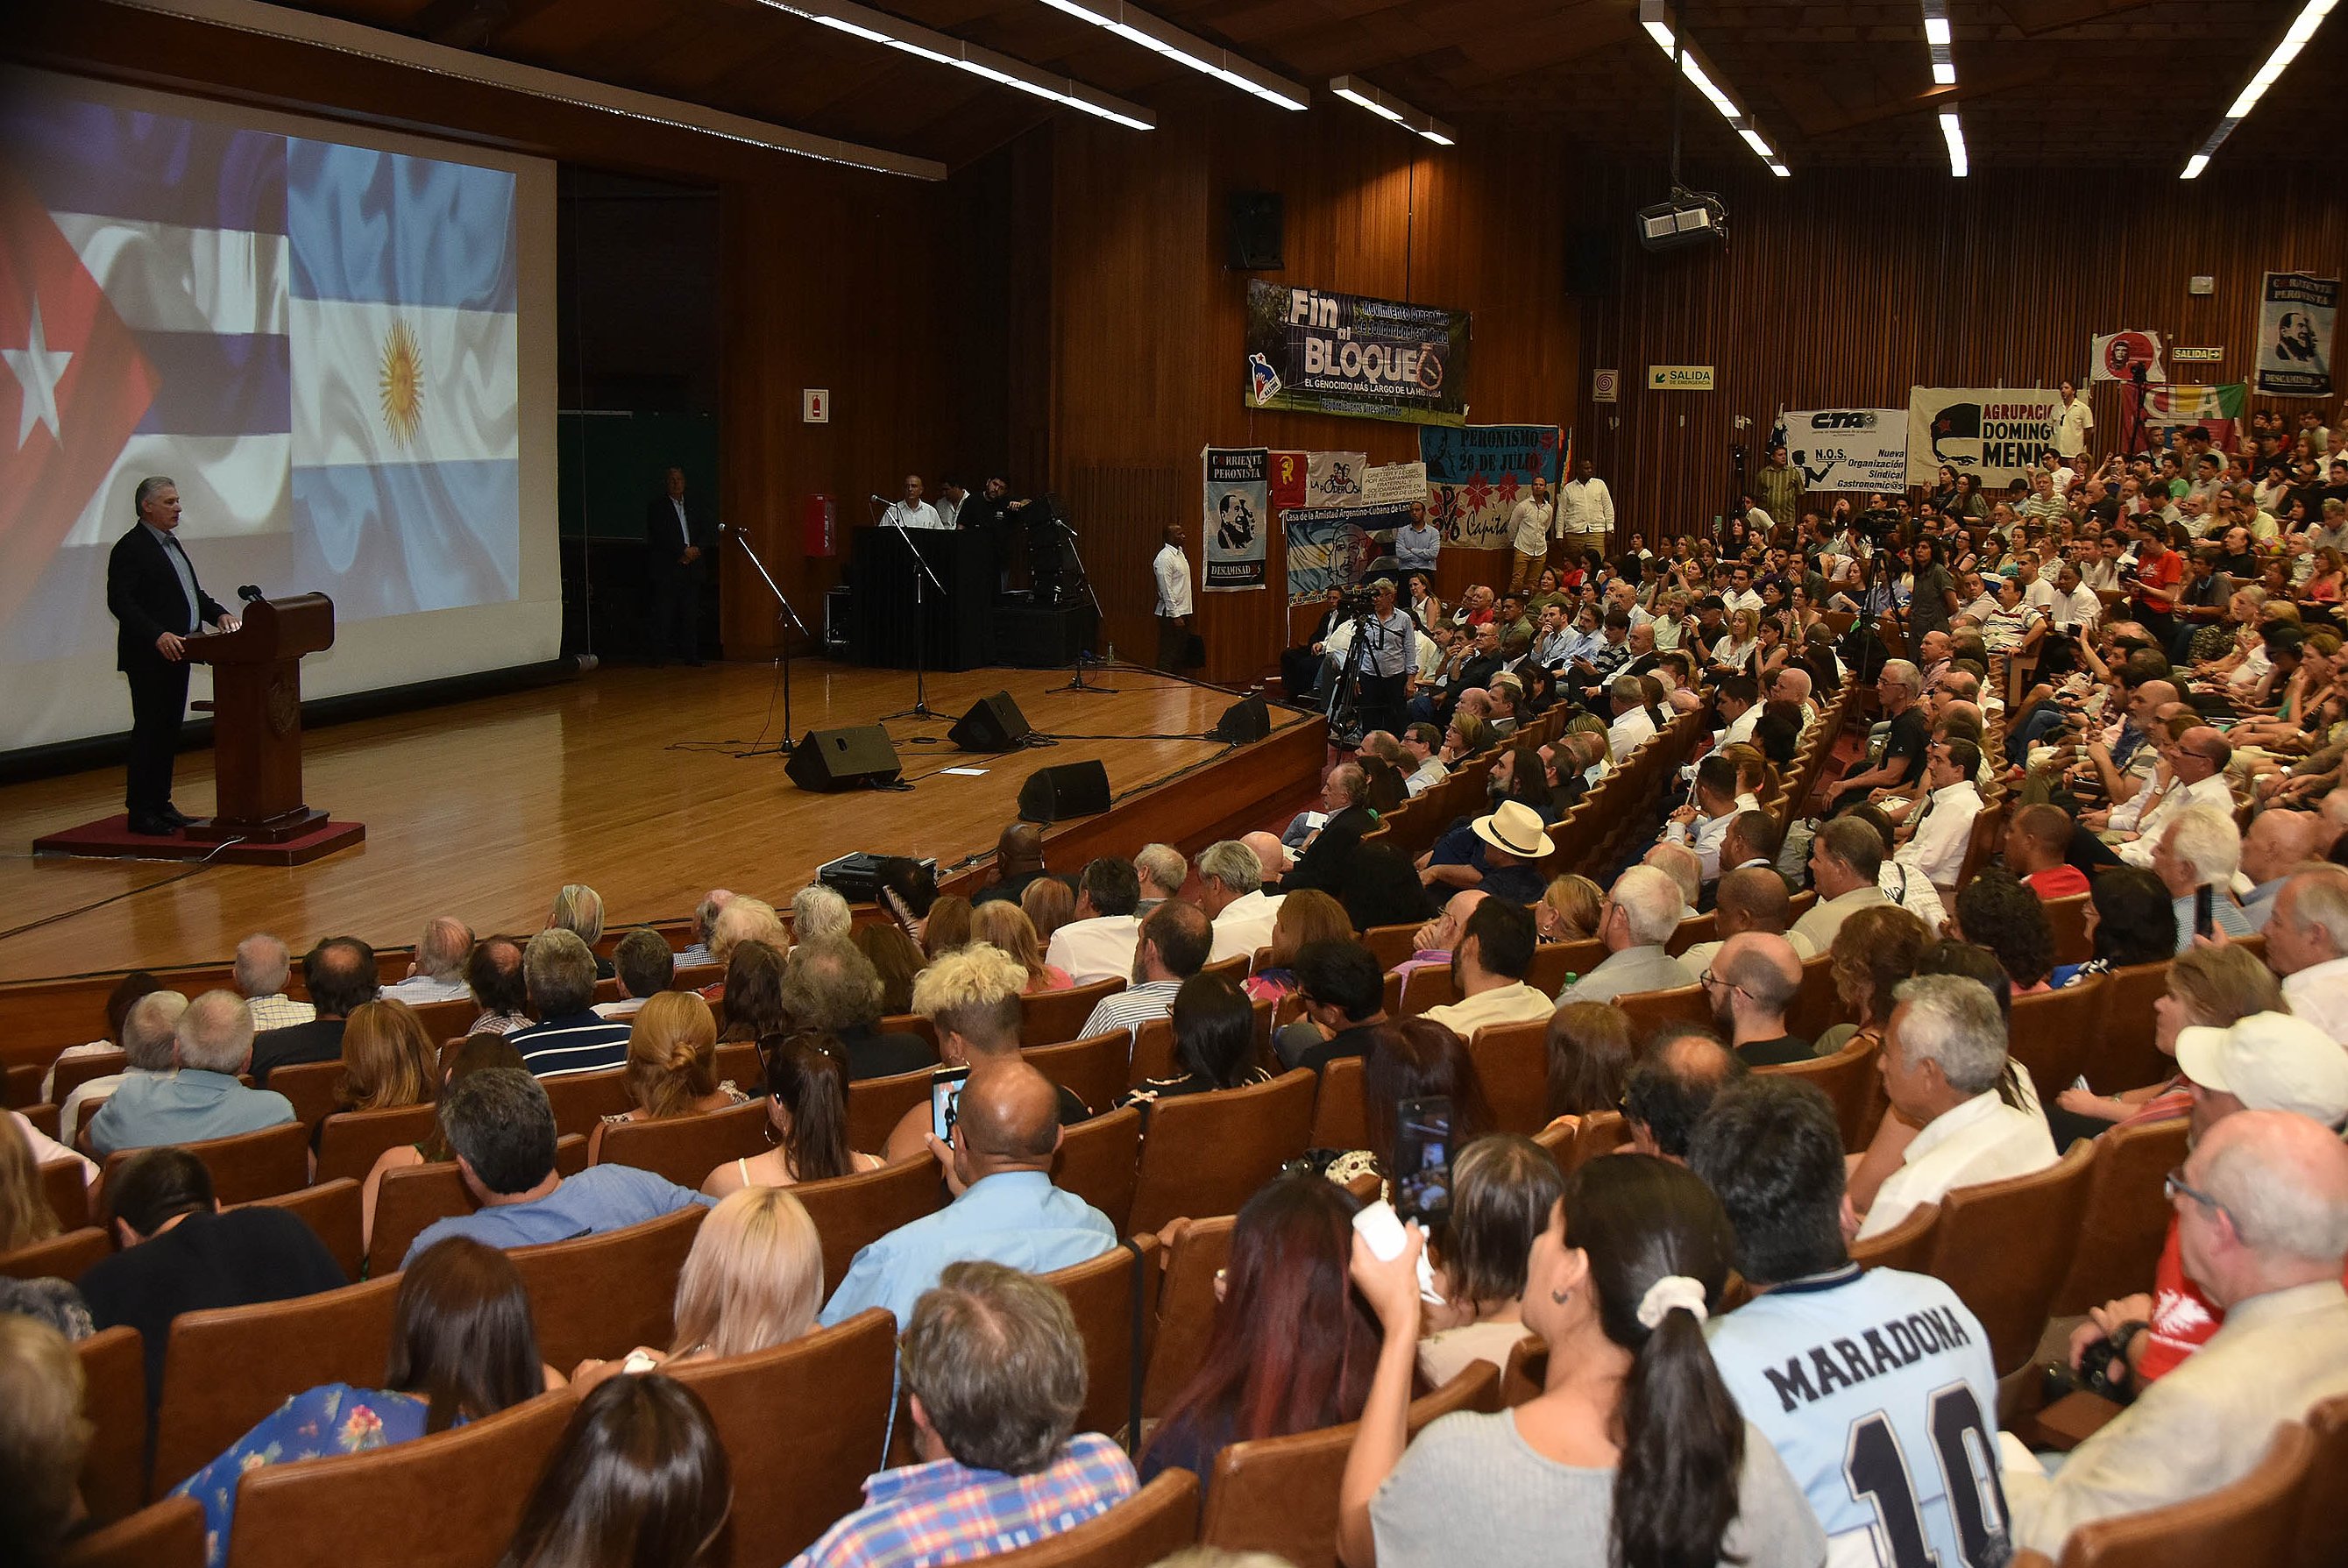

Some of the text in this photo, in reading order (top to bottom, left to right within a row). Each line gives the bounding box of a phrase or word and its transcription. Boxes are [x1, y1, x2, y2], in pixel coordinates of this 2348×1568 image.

[1291, 289, 1338, 329] Fin
[1363, 302, 1410, 321] Movimiento
[1337, 327, 1351, 341] al
[2174, 350, 2207, 359] SALIDA
[1305, 337, 1444, 391] BLOQUEO
[1670, 371, 1711, 380] SALIDA
[1304, 379, 1442, 398] EL GENOCIDIO MÁS LARGO DE LA HISTORIA
[1811, 412, 1866, 429] CTA
[1460, 429, 1539, 448] PERONISMO
[1983, 422, 2054, 440] DOMING
[1479, 454, 1496, 472] DE
[1500, 452, 1539, 471] JULIO
[1815, 448, 1847, 459] N.O.S.
[1877, 449, 1905, 458] Nueva
[1848, 458, 1904, 468] Organización
[1214, 467, 1261, 479] PERONISTA
[1868, 470, 1904, 479] Sindical
[1310, 479, 1362, 494] LA PODEROSA
[1837, 479, 1904, 490] Gastronomic@s
[1286, 511, 1299, 521] Casa
[1299, 511, 1308, 521] de
[1308, 510, 1314, 520] la
[1315, 508, 1339, 520] Amistad
[1339, 505, 1390, 520] Argentino-Cubana
[1390, 504, 1399, 514] de
[1763, 1305, 1971, 1413] MARADONA
[1842, 1379, 2011, 1568] 10
